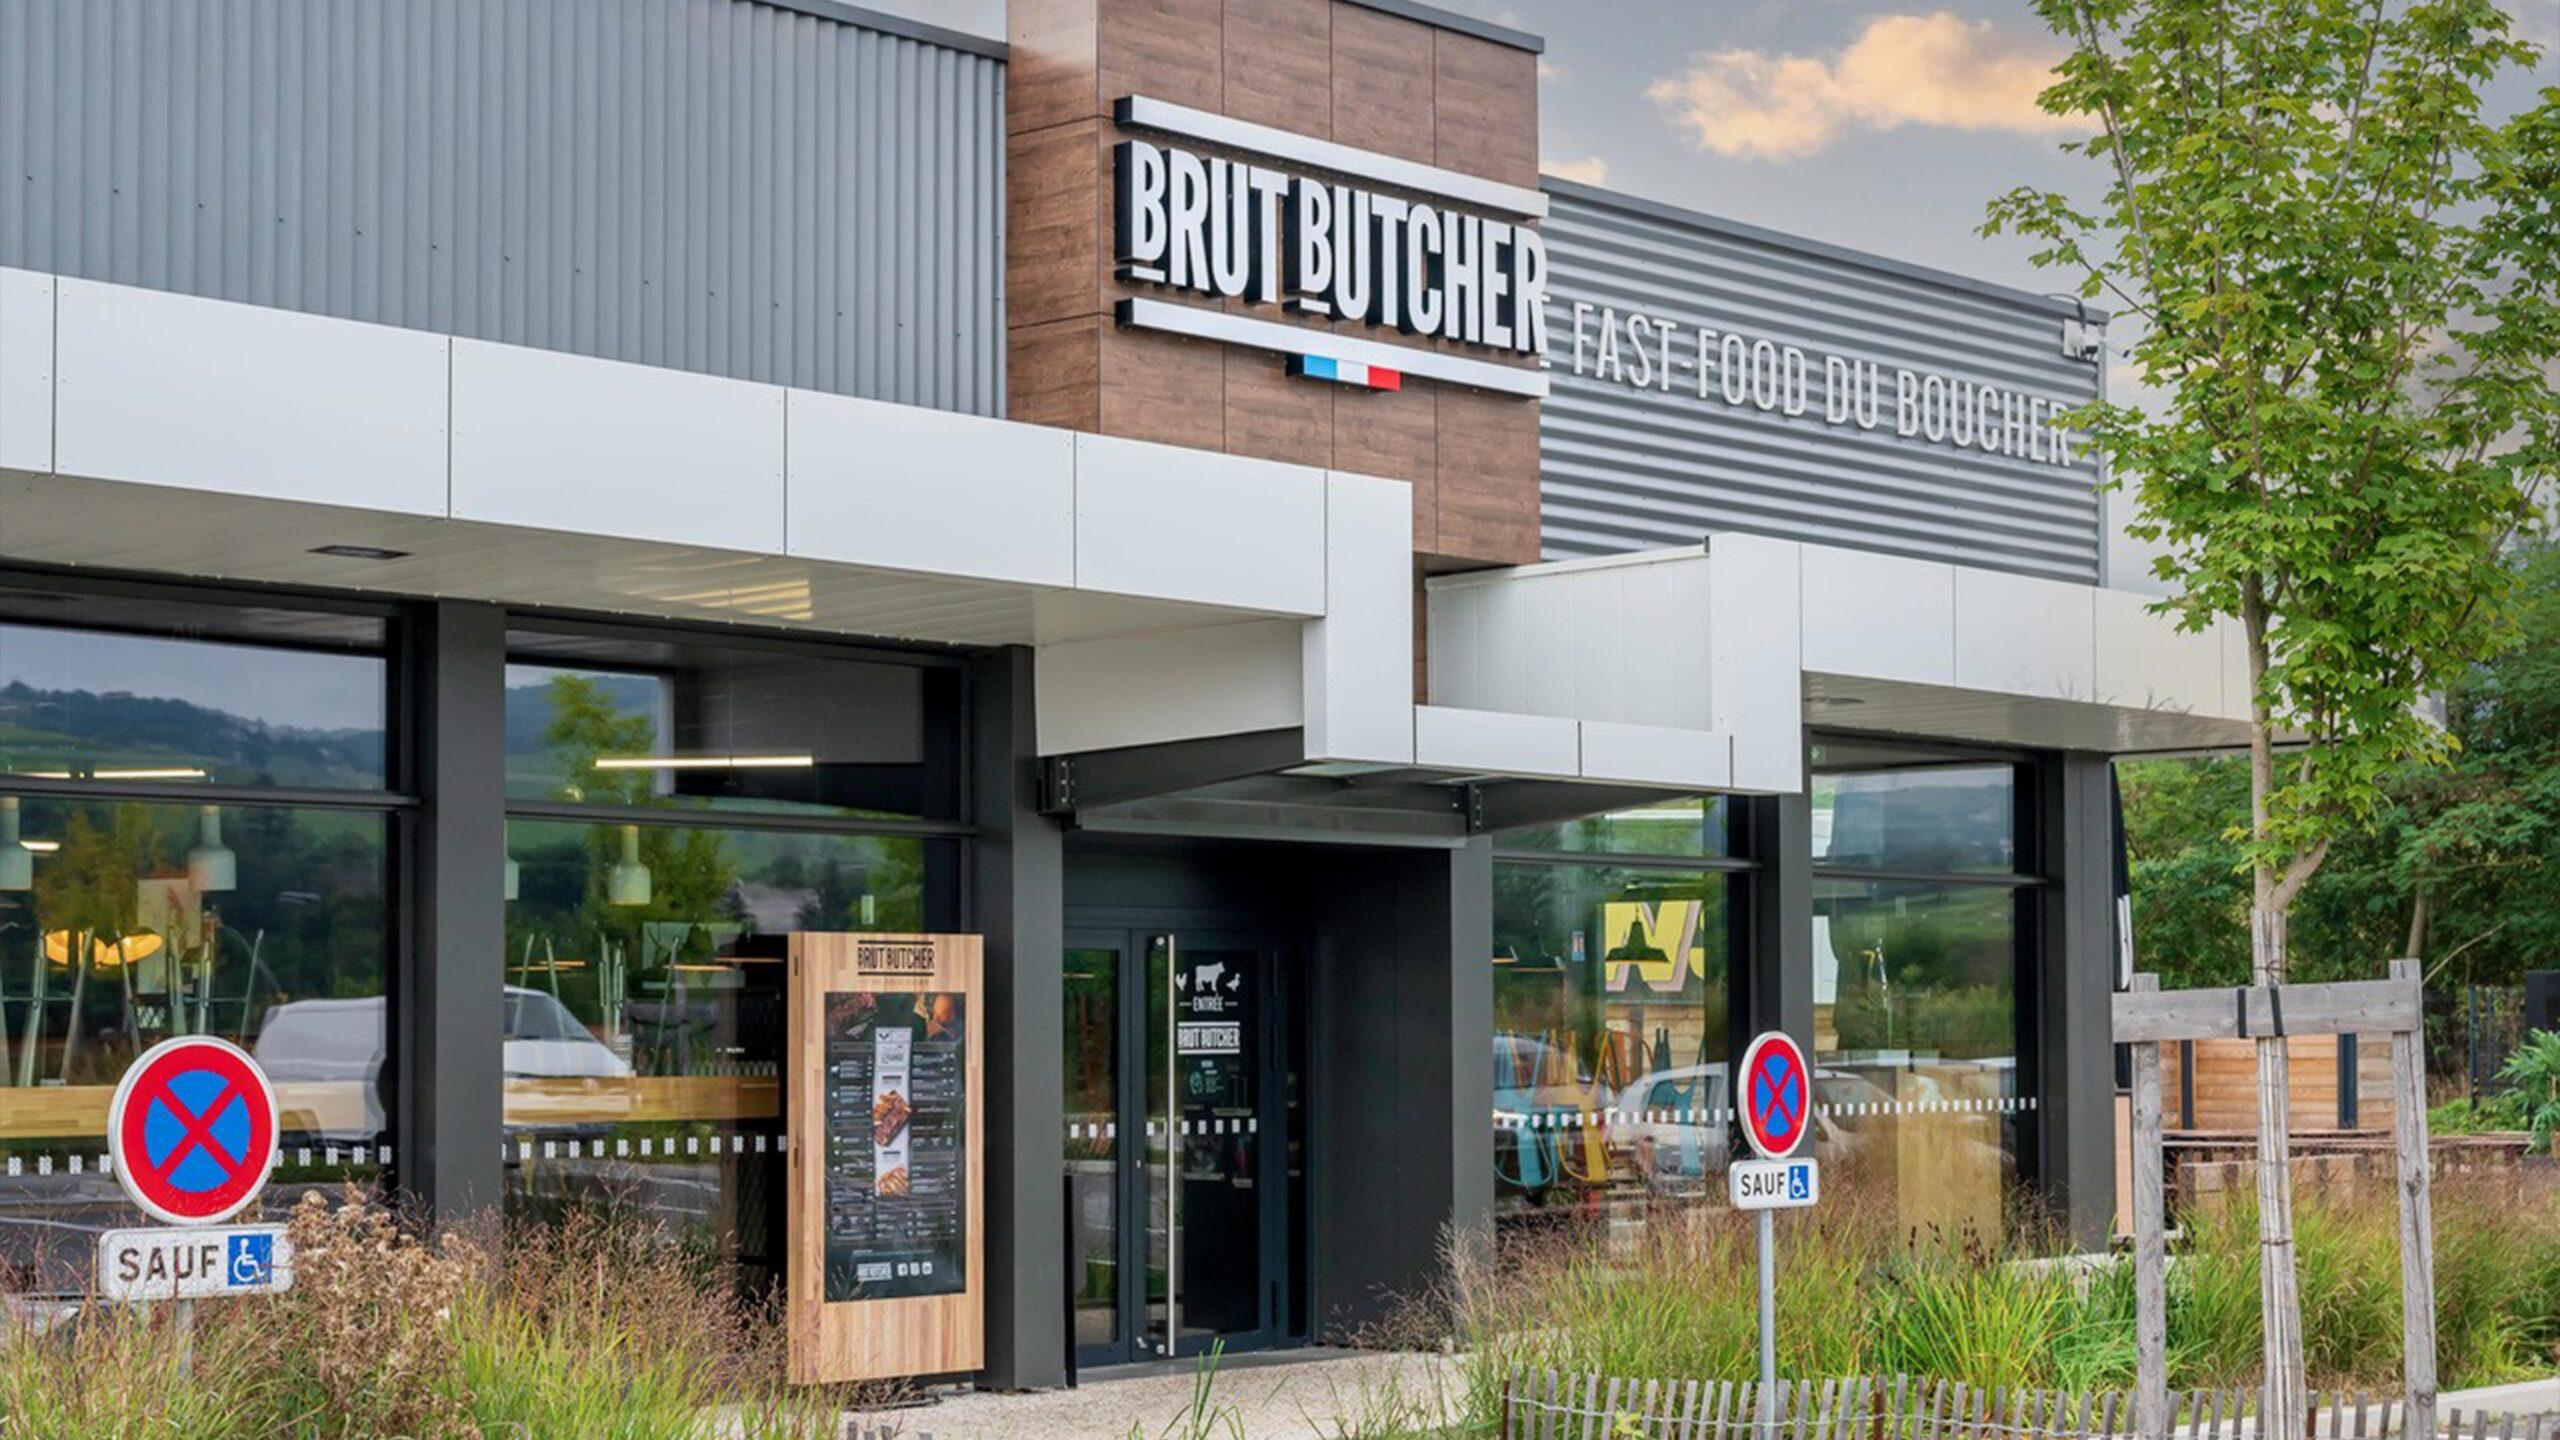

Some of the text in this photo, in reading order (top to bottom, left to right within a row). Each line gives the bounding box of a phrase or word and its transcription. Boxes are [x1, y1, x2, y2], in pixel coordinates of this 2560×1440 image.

[1118, 140, 1289, 304] BRUT
[1296, 177, 1549, 354] BUTCHER
[1573, 301, 1807, 417] FAST-FOOD
[1825, 356, 1879, 431] DU
[1897, 369, 2071, 466] BOUCHER
[858, 947, 935, 969] BRUT BUTCHER
[1178, 1028, 1240, 1048] BRUT BUTCHER
[1741, 1172, 1786, 1197] SAUF
[118, 1245, 219, 1281] SAUF
